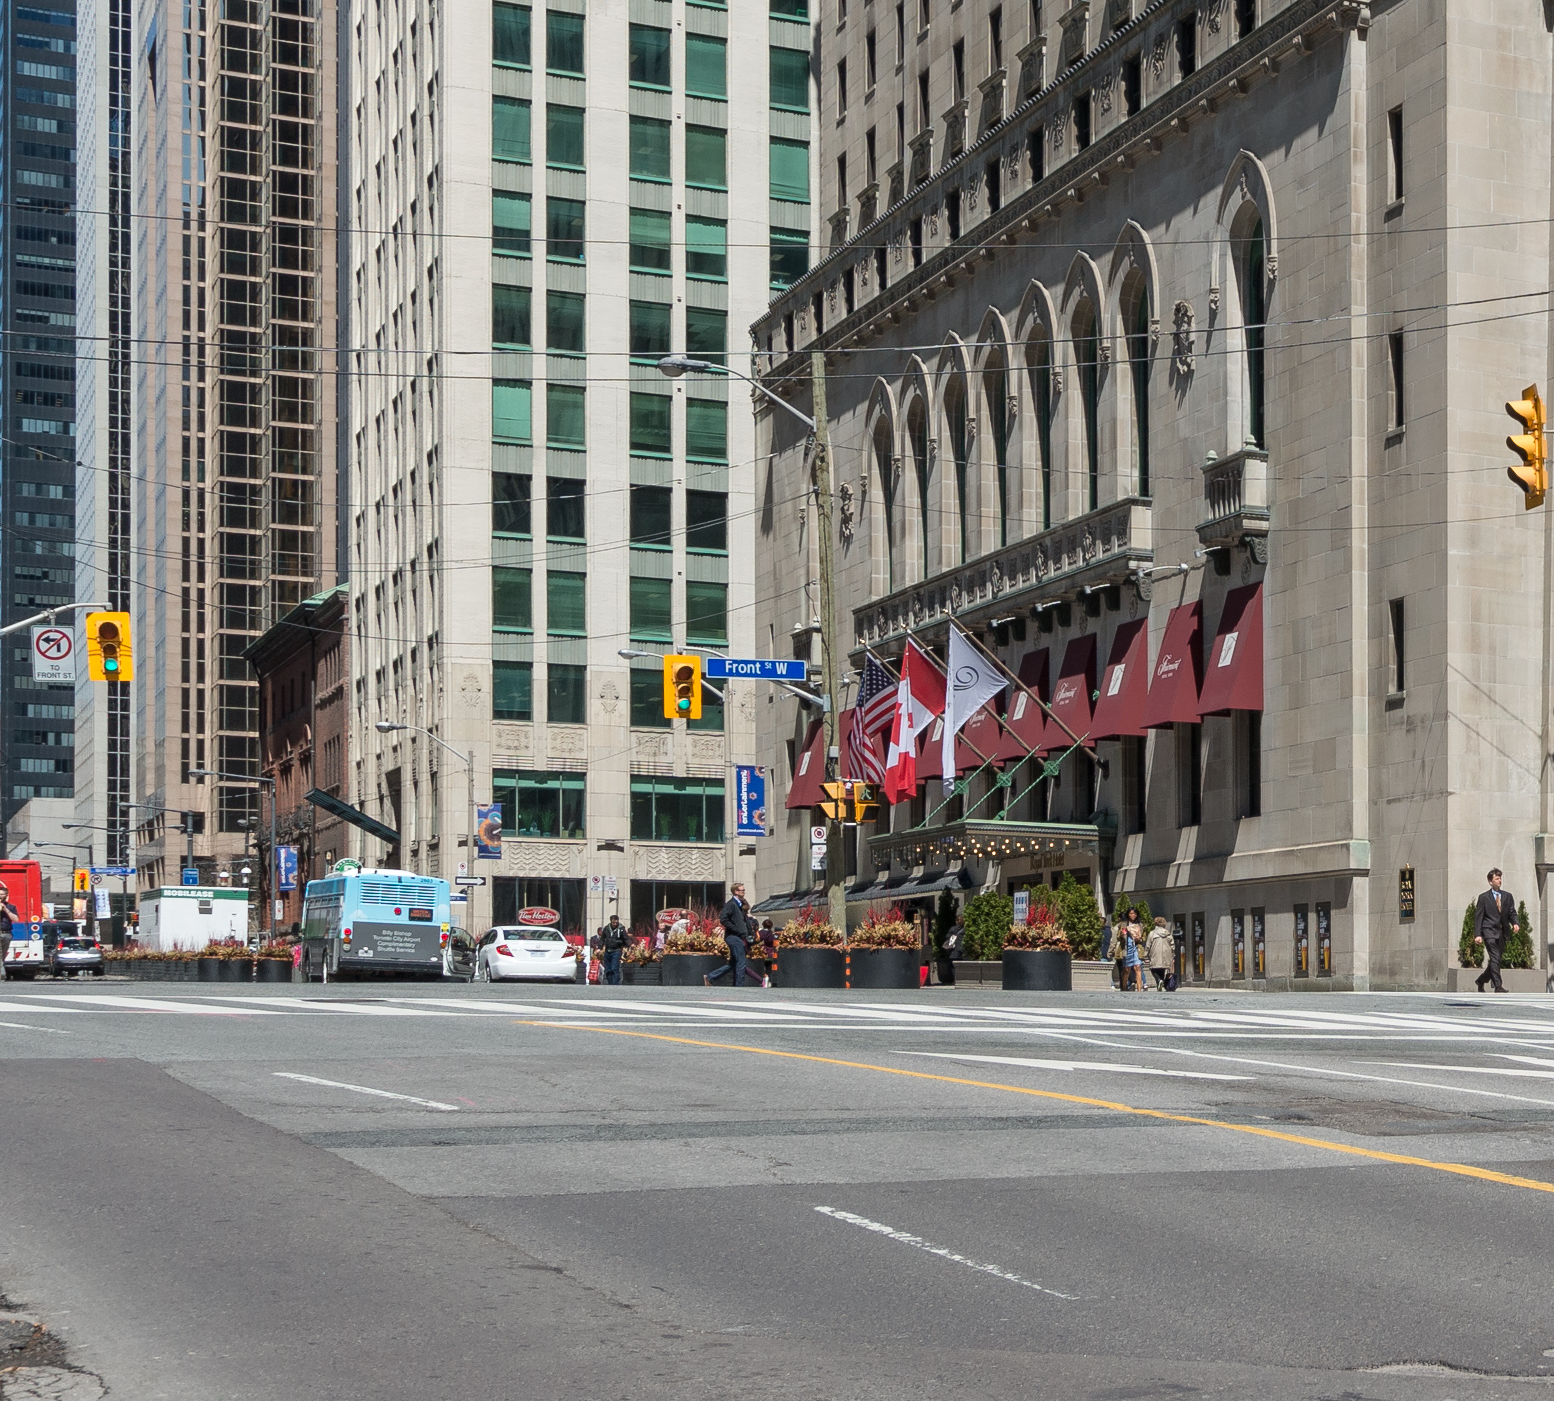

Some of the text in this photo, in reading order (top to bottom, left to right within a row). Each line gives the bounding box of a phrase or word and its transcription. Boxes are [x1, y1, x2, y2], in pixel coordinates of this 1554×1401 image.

[725, 660, 788, 675] Front St W
[740, 769, 749, 824] entertainment
[163, 889, 214, 897] MOBILEASE
